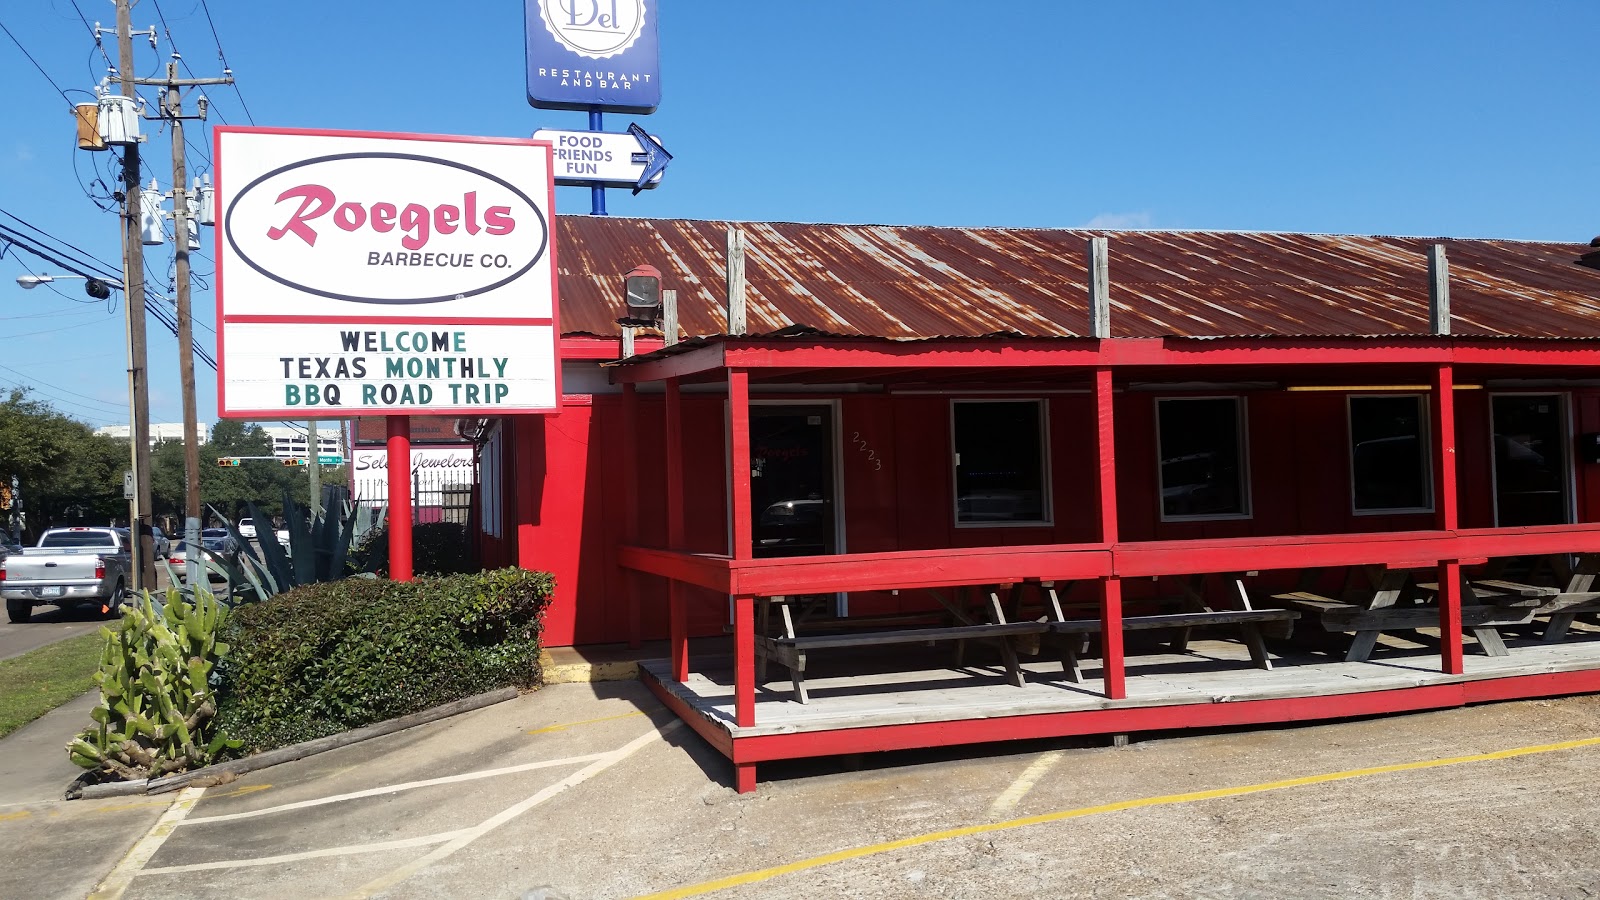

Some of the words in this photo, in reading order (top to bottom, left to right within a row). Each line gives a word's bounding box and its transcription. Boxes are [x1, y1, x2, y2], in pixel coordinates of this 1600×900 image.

[538, 68, 651, 83] RESTAURANT
[560, 79, 593, 88] AND
[600, 81, 632, 90] BAR
[559, 135, 603, 149] FOOD
[566, 162, 598, 175] FUN
[266, 183, 516, 251] Roegels
[367, 251, 474, 268] BARBECUE
[480, 254, 513, 269] CO.
[340, 331, 467, 353] WELCOME
[279, 357, 367, 379] TEXAS
[385, 357, 509, 379] MONTHLY
[285, 384, 342, 406] BBQ
[362, 384, 433, 406] ROAD
[448, 383, 509, 405] TRIP
[853, 431, 882, 471] 2223
